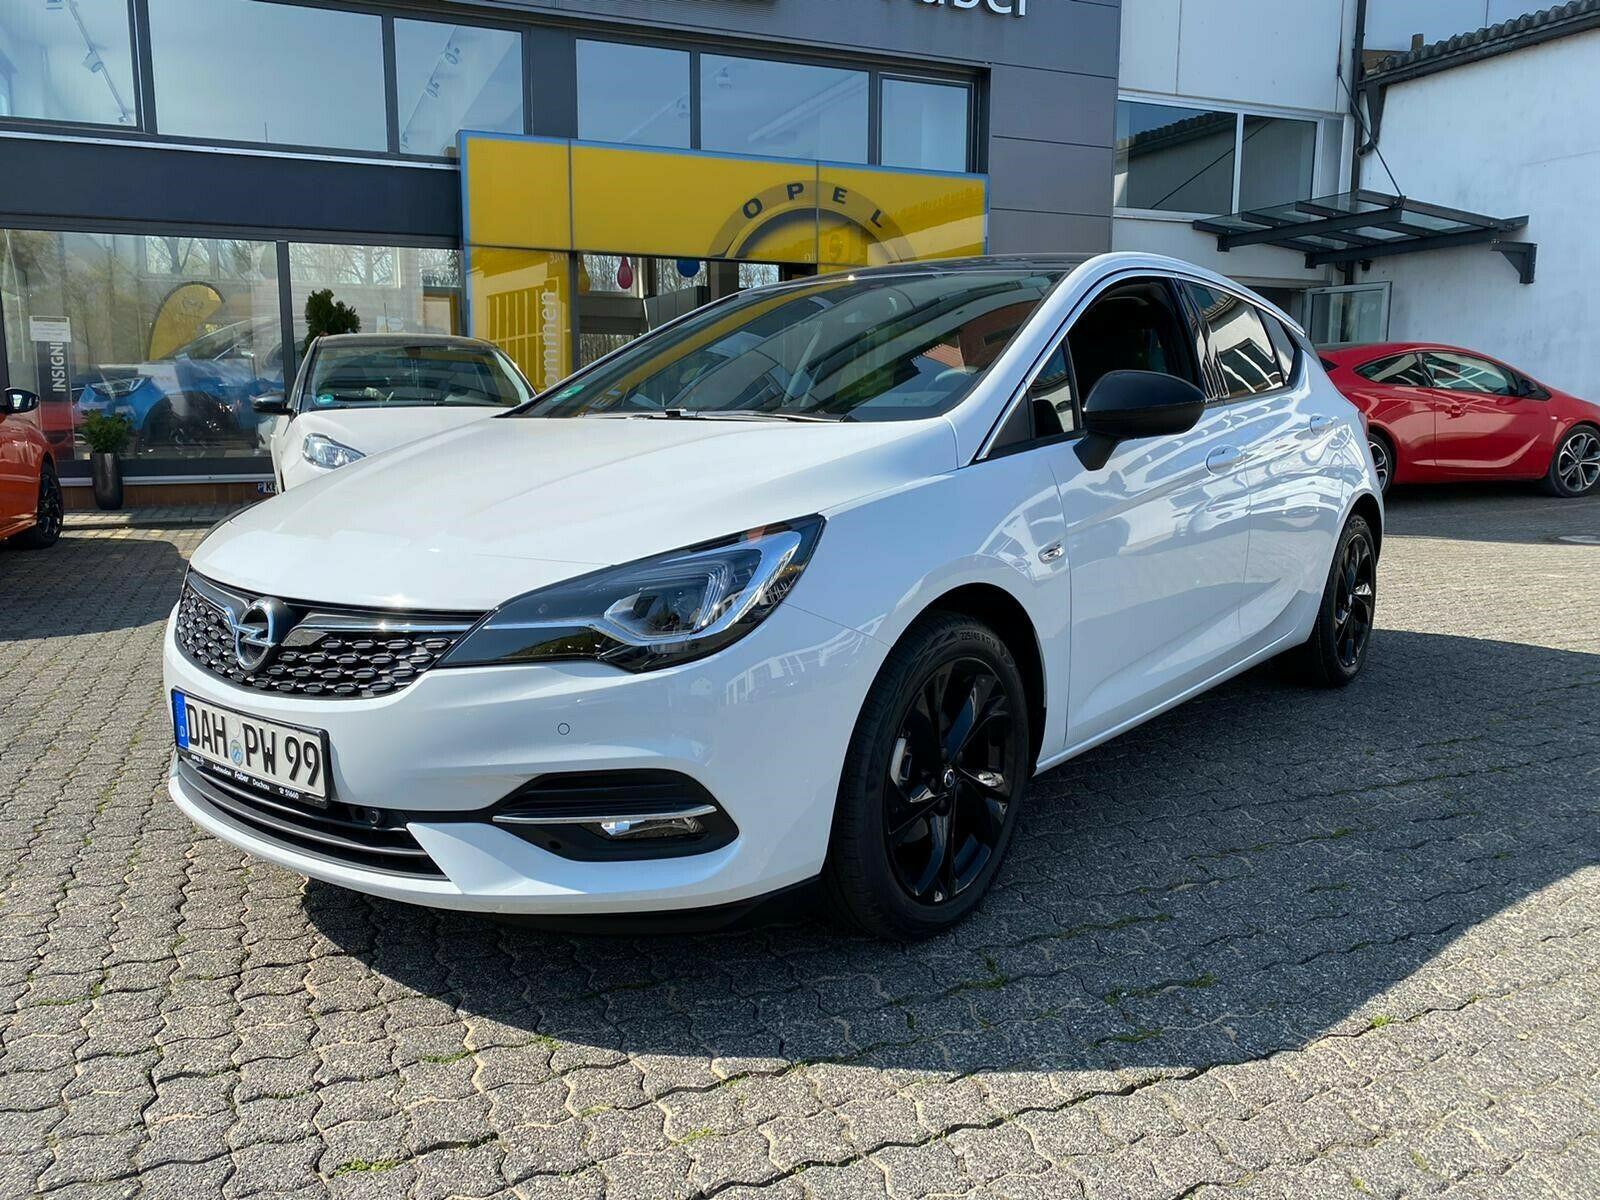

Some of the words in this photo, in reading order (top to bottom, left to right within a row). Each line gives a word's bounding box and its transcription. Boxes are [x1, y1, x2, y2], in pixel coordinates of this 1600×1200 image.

[742, 182, 883, 229] OPEL
[49, 342, 66, 392] INSIGNI
[179, 725, 185, 738] D
[186, 703, 229, 759] DAH
[242, 723, 277, 776] PW
[285, 736, 320, 787] 99
[234, 770, 249, 783] Faber
[252, 779, 270, 791] Dachau
